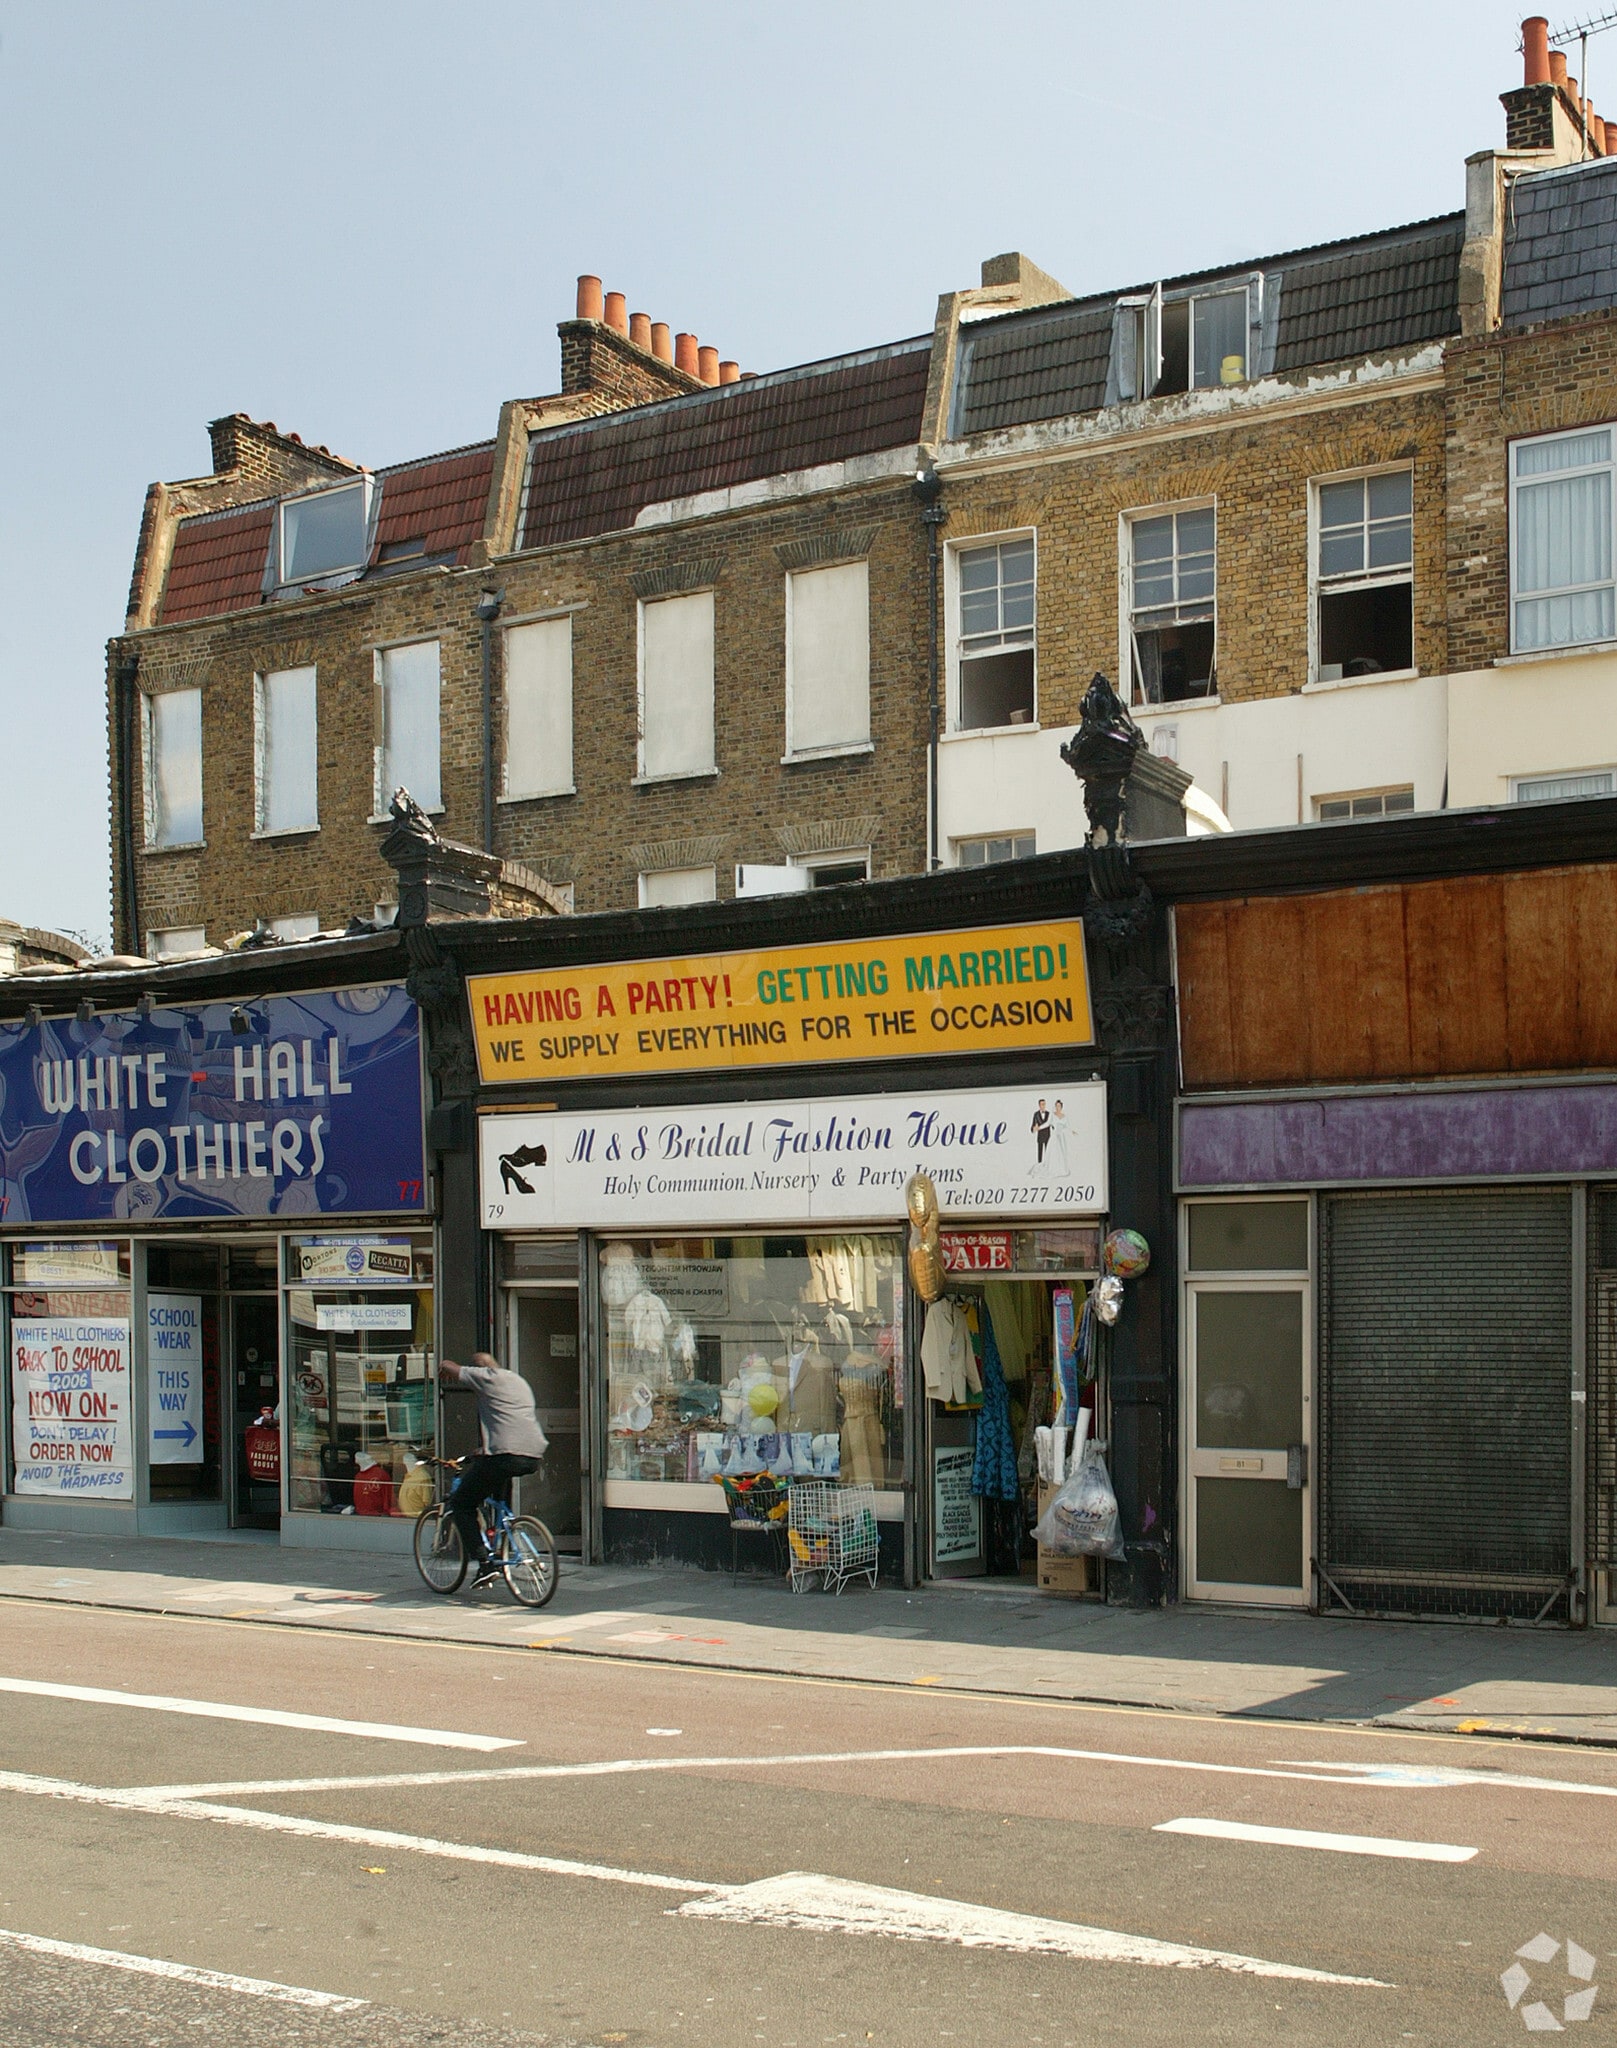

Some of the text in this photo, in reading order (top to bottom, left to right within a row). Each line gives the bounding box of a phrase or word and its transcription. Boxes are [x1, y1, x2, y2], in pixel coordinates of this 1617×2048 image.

[483, 943, 1069, 1027] HAVING A PARTY! GETTING MARRIED!
[490, 998, 1074, 1063] WE SUPPLY EVERYTHING FOR THE OCCASION
[42, 1052, 167, 1114] WHITE
[234, 1037, 352, 1102] HALL
[566, 1110, 1009, 1163] M & S Bridal Fashion House
[69, 1114, 324, 1185] CLOTHIERS
[397, 1180, 422, 1201] 77
[604, 1176, 641, 1199] Holy
[832, 1167, 846, 1186] &
[857, 1166, 907, 1189] Party
[1010, 1187, 1049, 1203] 7277
[1054, 1185, 1095, 1202] 2050
[488, 1204, 504, 1219] 79
[370, 1253, 408, 1269] REGATTA
[150, 1308, 197, 1328] SCHOOL
[365, 1308, 407, 1318] CLOTHIERS
[16, 1326, 126, 1342] WHITE HALL CLOTHIERS
[17, 1346, 48, 1372] BACK
[72, 1346, 125, 1373] SCHOOL
[51, 1373, 89, 1391] 2006
[158, 1370, 190, 1389] THIS
[29, 1391, 73, 1418] NOW
[159, 1393, 188, 1411] WAY
[30, 1426, 65, 1440] DON'T
[30, 1444, 113, 1462] ORDER NOW
[21, 1464, 82, 1481] AVOID THE
[60, 1472, 124, 1490] MADNESS
